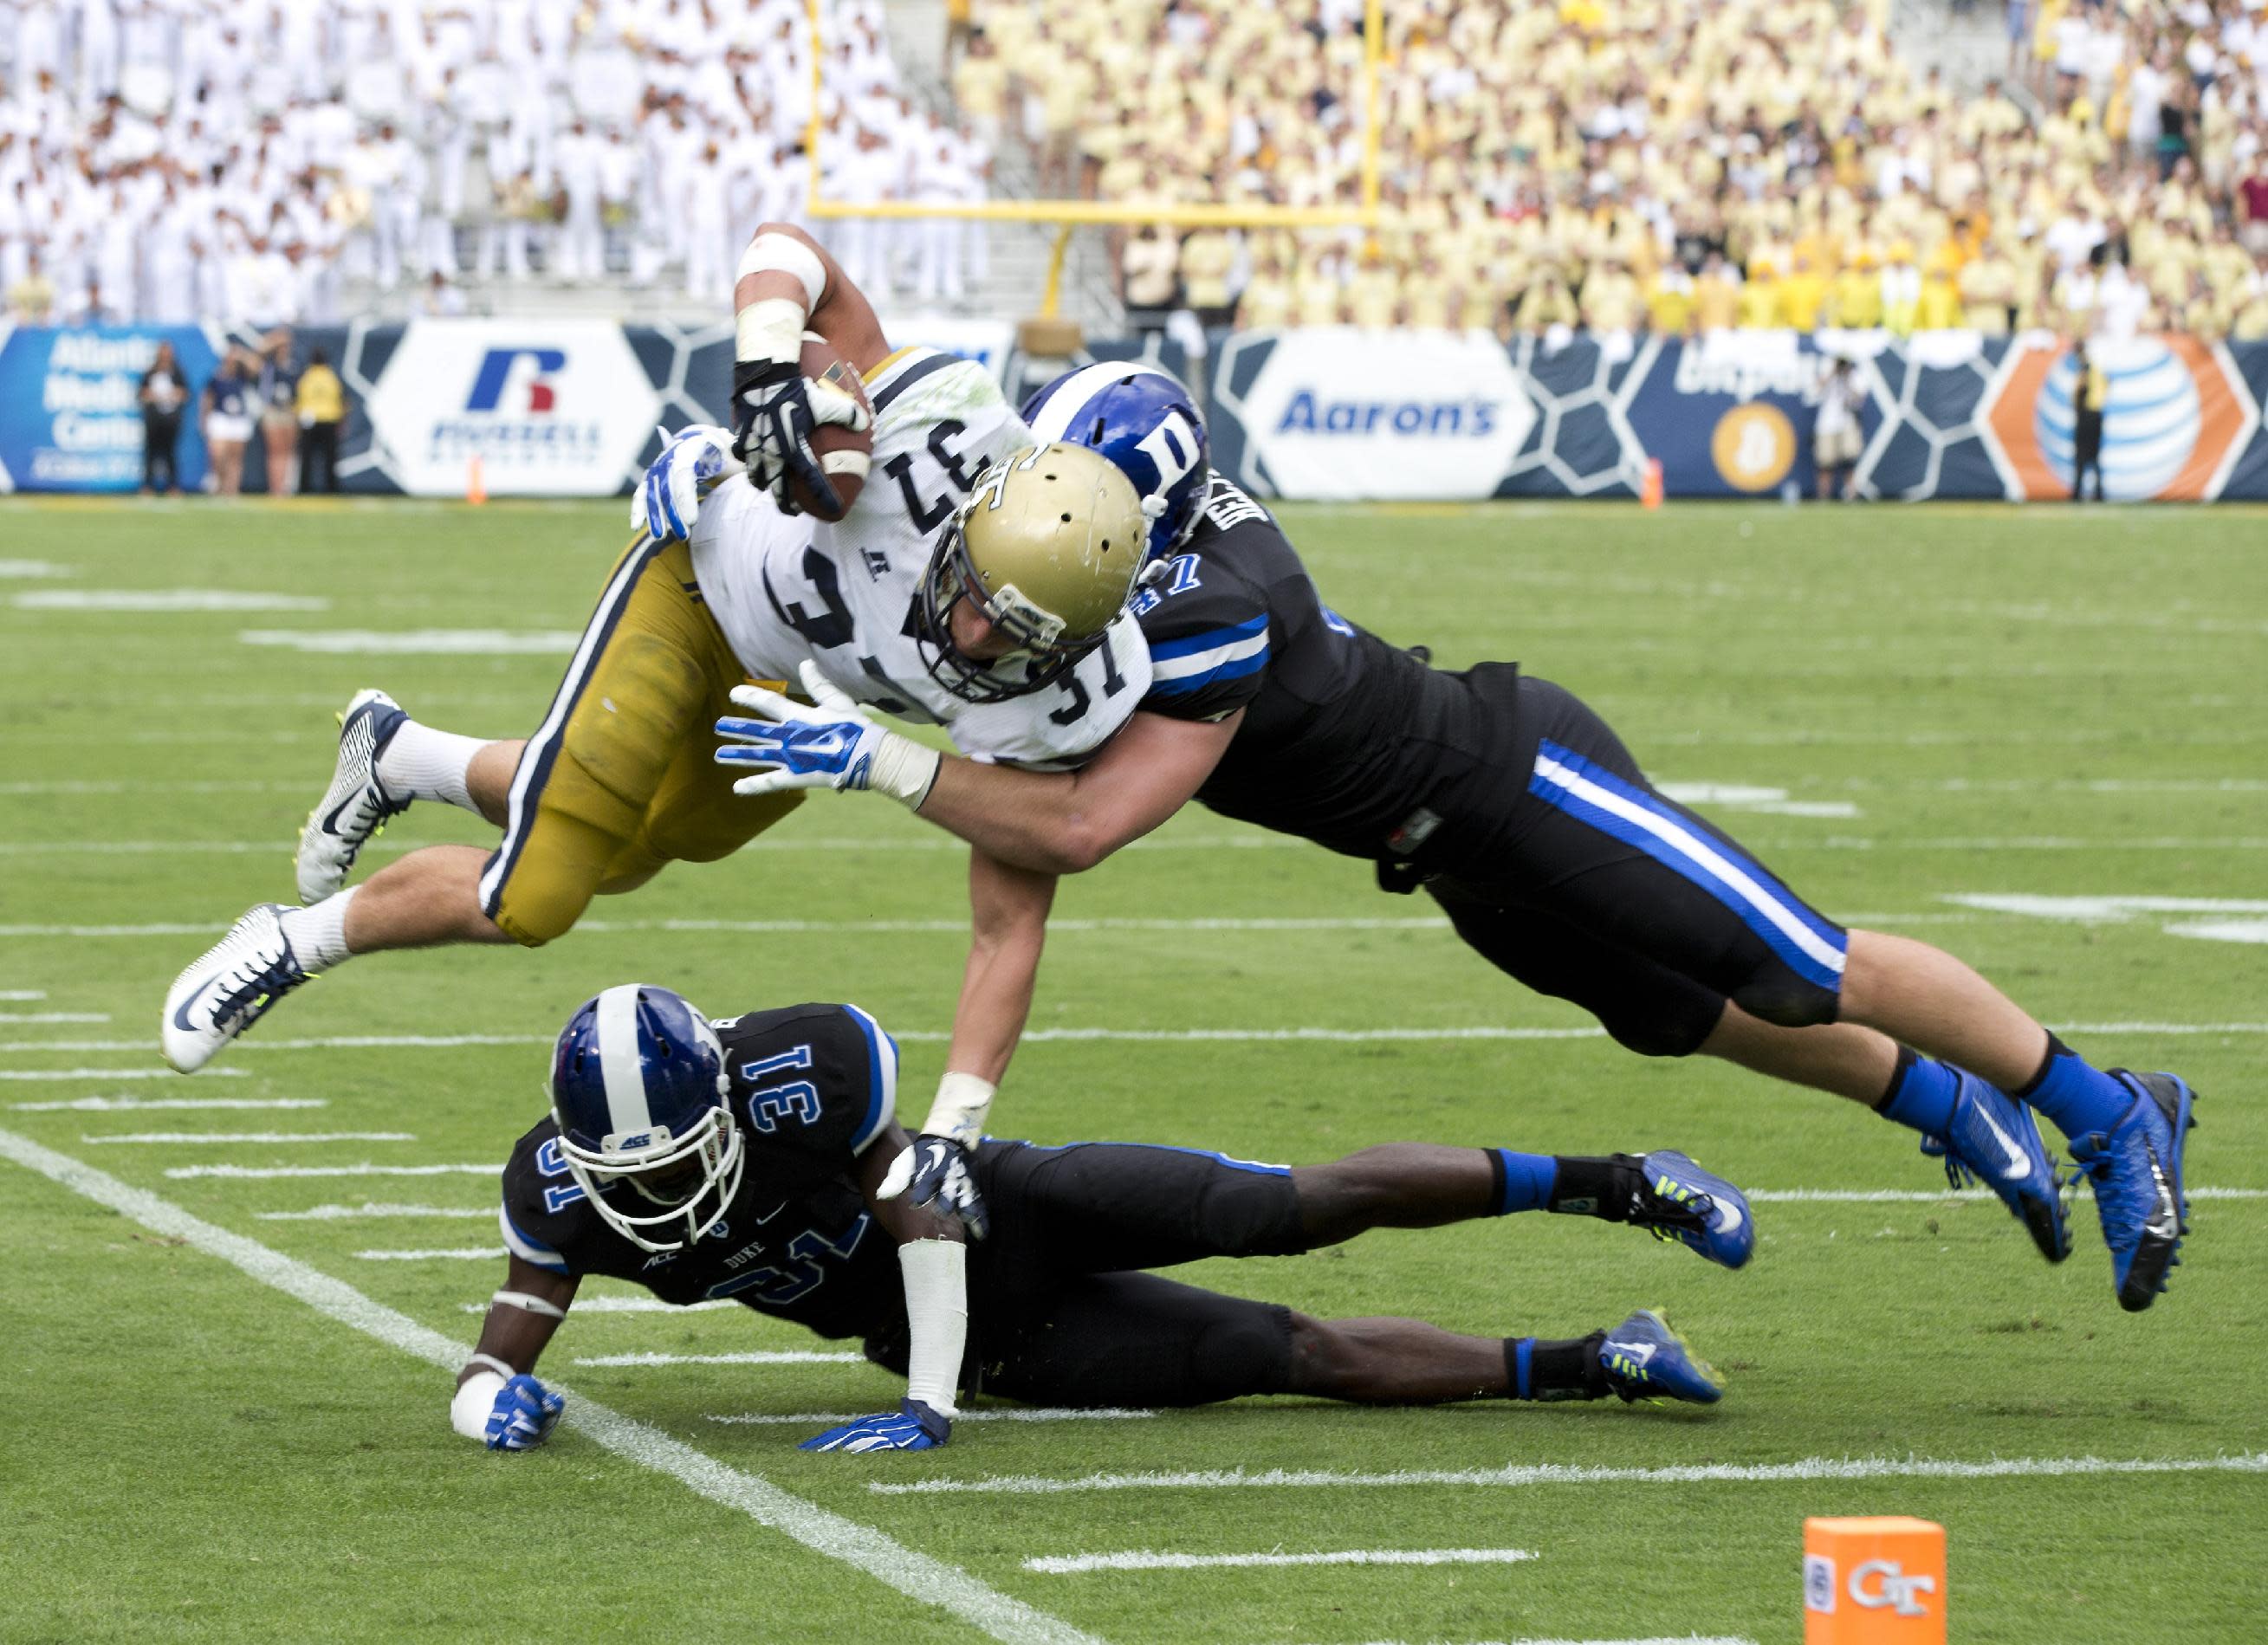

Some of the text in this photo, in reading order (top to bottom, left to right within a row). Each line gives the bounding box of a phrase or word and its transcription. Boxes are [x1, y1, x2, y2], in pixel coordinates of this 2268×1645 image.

[52, 410, 147, 452] Cente
[1275, 387, 1500, 435] Aaron's
[883, 419, 992, 535] 37
[742, 1044, 823, 1133] 31
[641, 1249, 678, 1272] ACC
[722, 1240, 766, 1270] DUKE
[1848, 1559, 1935, 1616] GT
